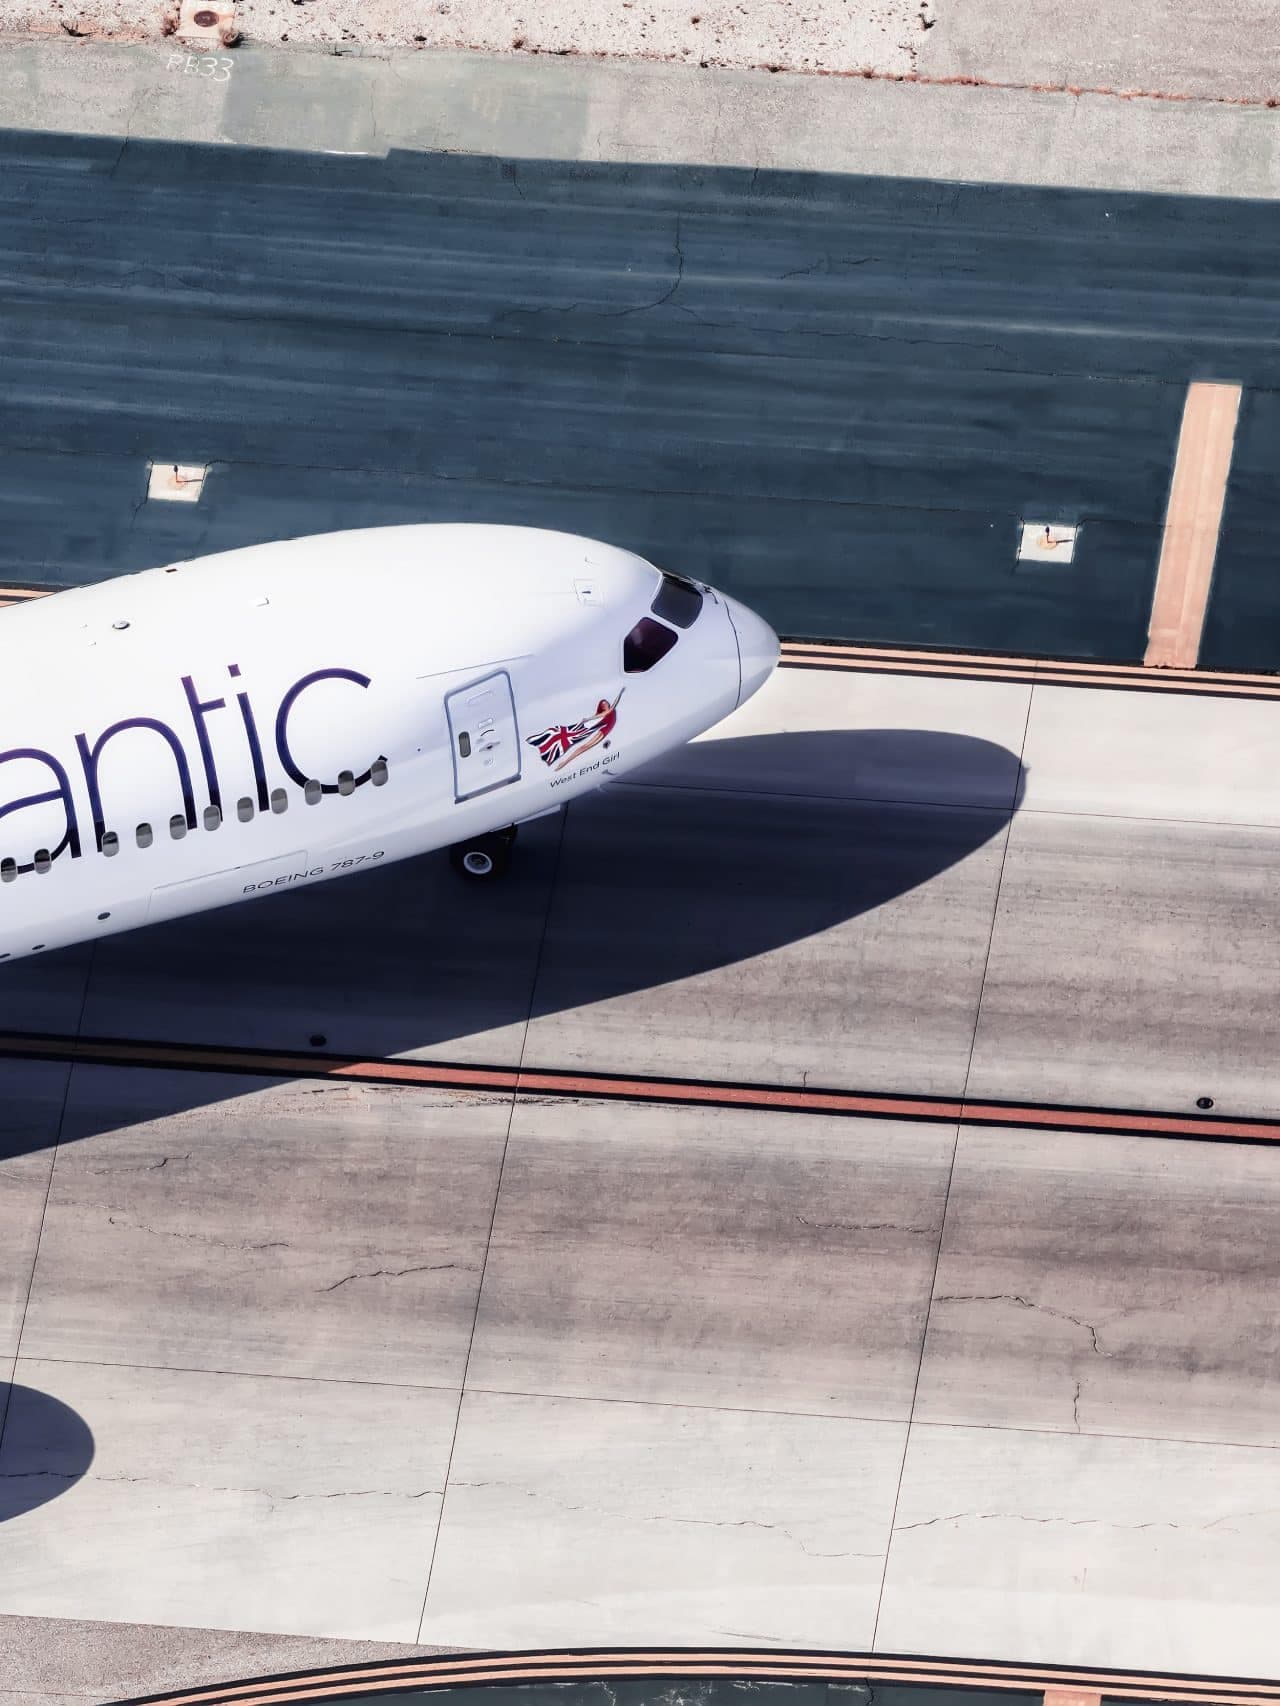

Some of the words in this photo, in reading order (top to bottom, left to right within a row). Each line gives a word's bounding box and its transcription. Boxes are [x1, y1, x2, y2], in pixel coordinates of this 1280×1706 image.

[550, 774, 577, 788] West
[579, 763, 600, 777] End
[602, 751, 620, 766] Girl
[243, 867, 324, 894] BOEING
[331, 851, 385, 871] 787-9
